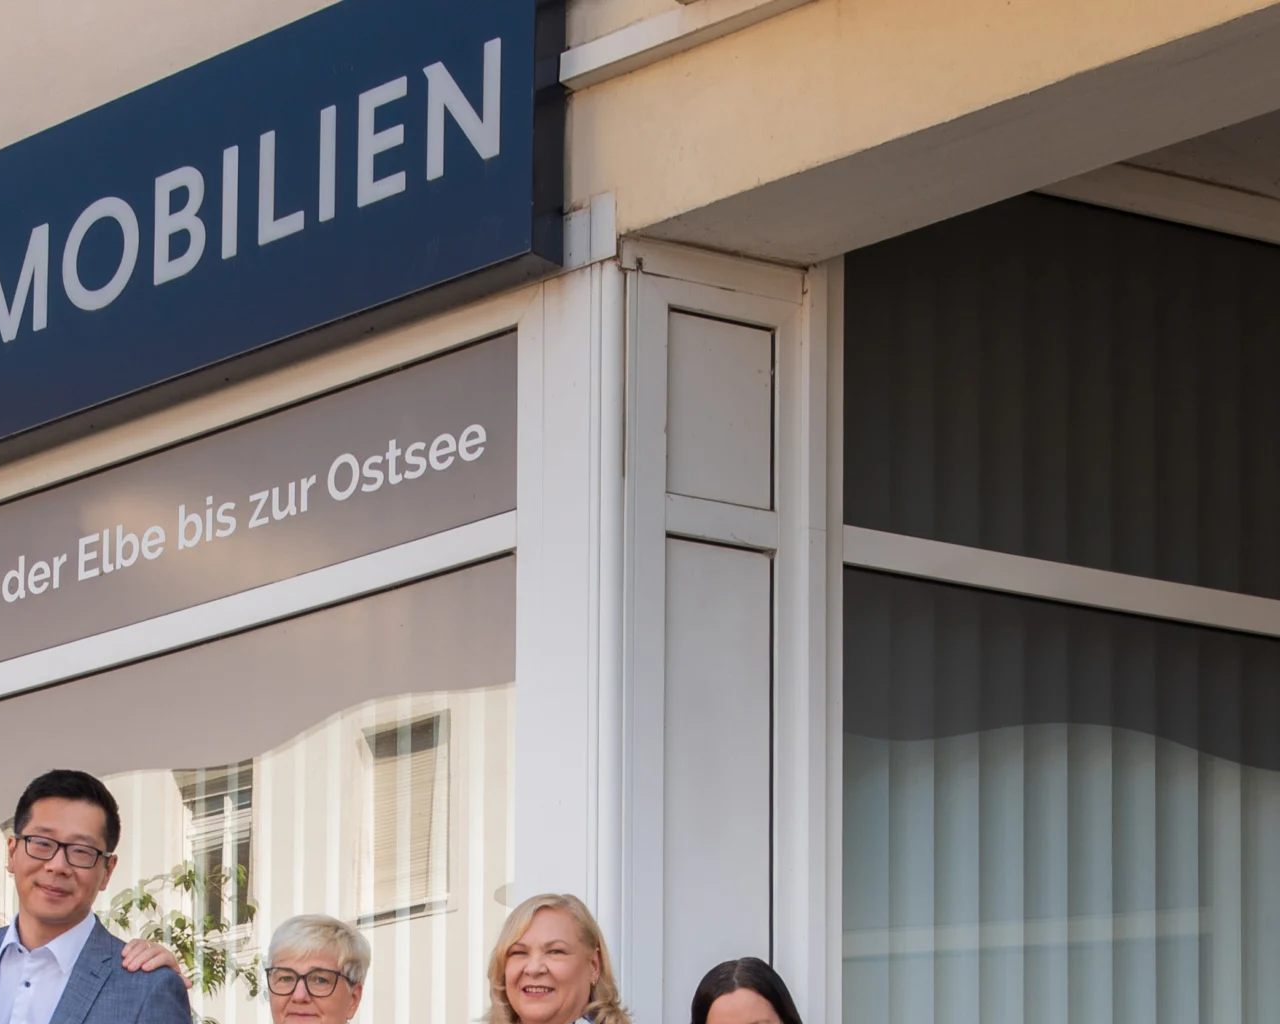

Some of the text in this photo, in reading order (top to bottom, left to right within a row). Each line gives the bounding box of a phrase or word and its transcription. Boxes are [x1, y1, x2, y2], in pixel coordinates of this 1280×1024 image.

[2, 555, 68, 603] der
[77, 524, 166, 582] Elbe
[177, 496, 237, 551] bis
[248, 474, 317, 530] zur
[327, 424, 487, 501] Ostsee
